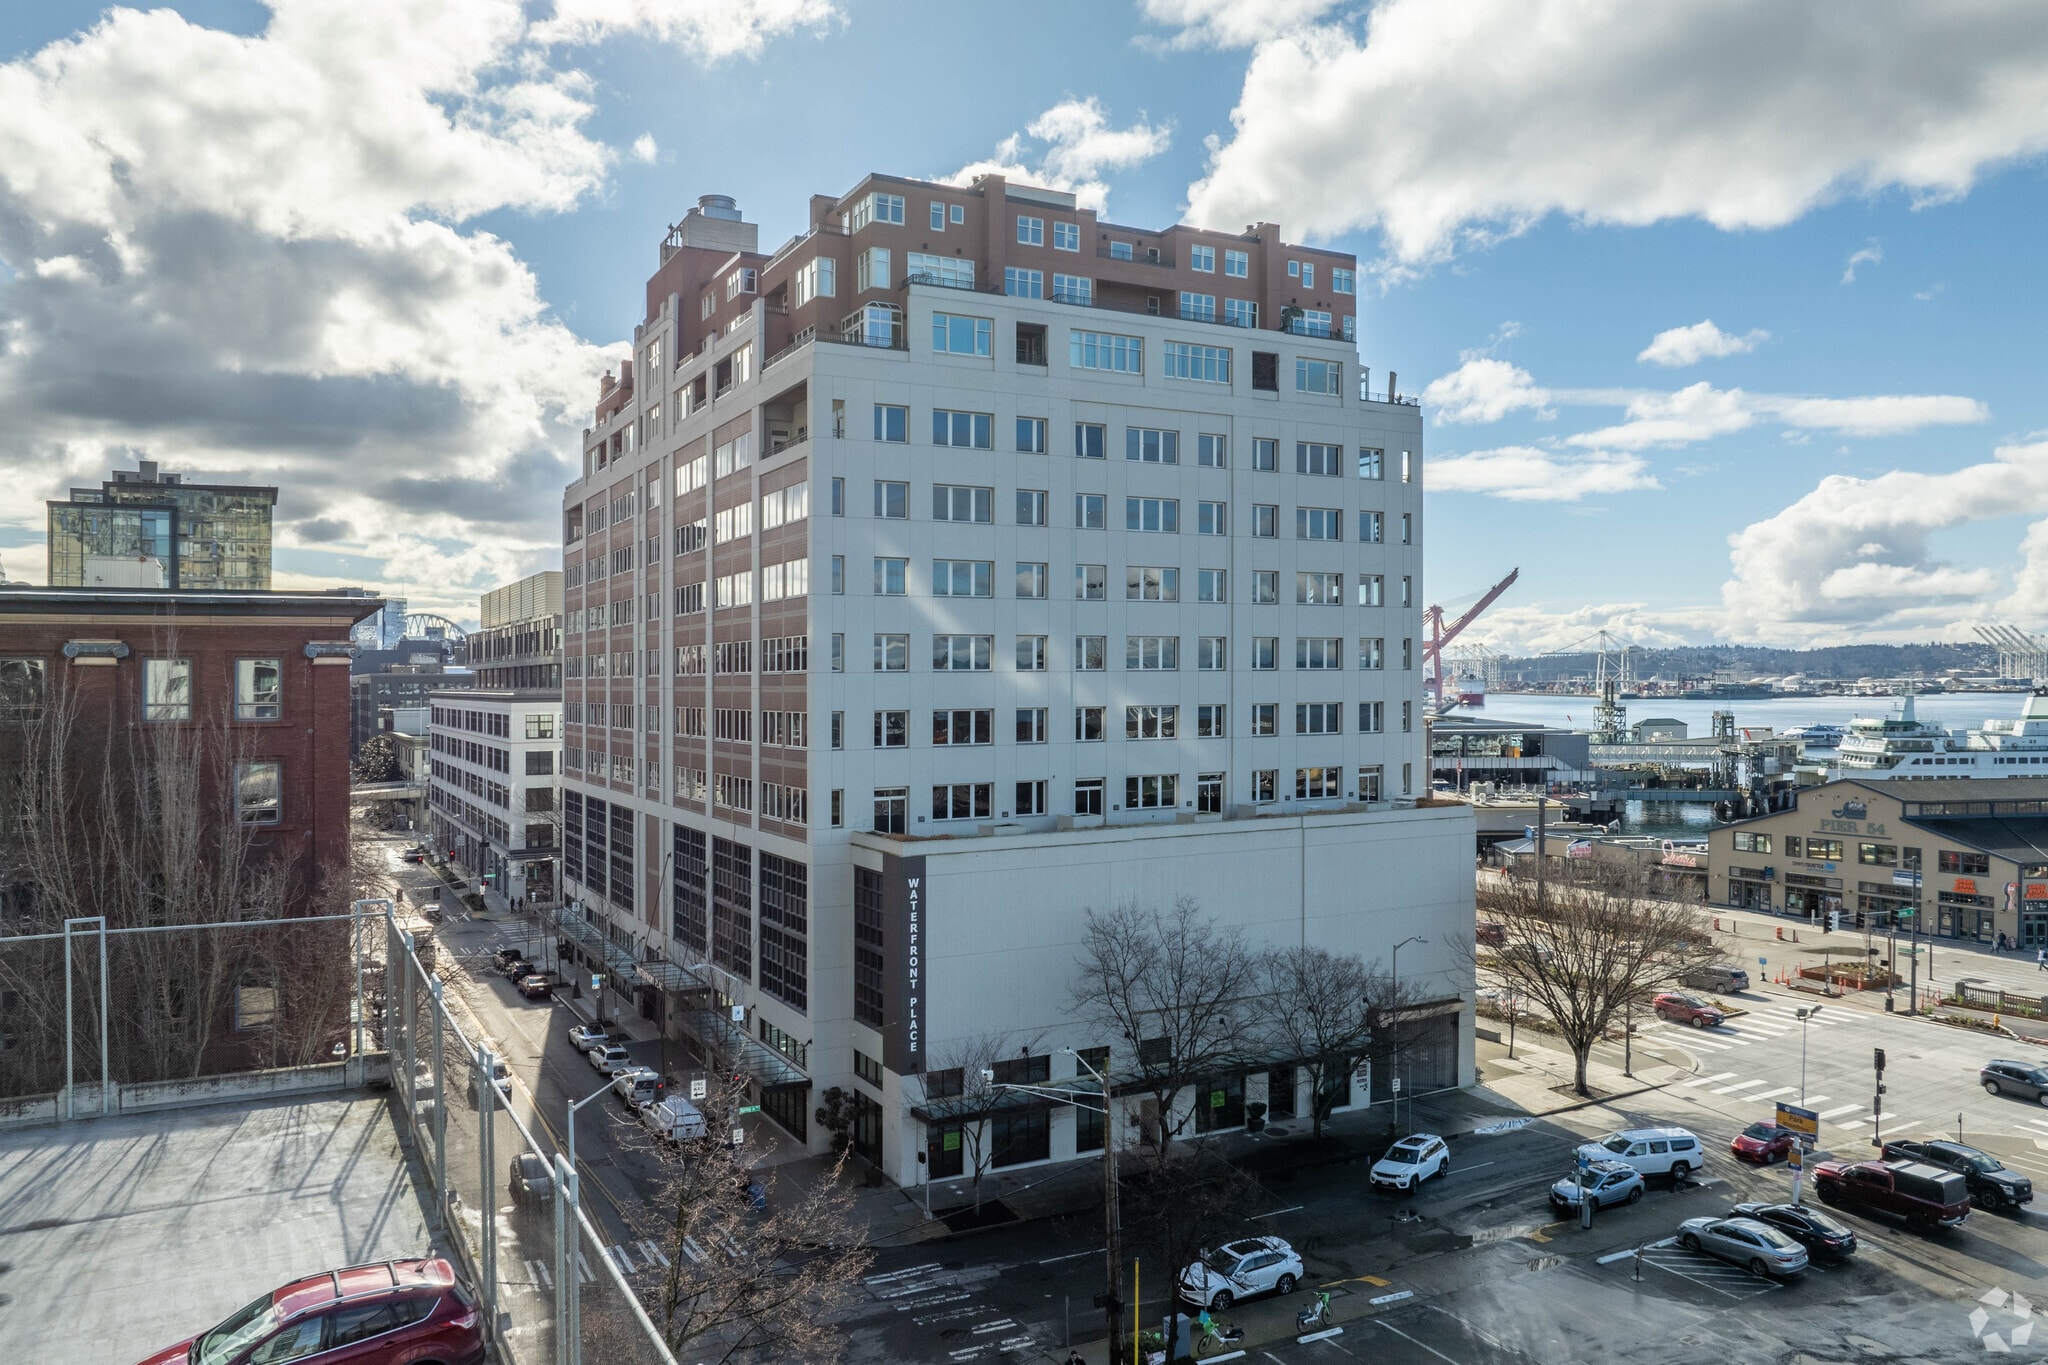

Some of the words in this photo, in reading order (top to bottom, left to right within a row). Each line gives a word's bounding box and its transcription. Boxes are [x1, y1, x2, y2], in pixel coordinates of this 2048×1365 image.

[1821, 819, 1857, 832] PIER
[1867, 823, 1885, 835] 54
[908, 878, 920, 989] WATERFRONT
[910, 998, 918, 1052] PLACE
[1789, 1115, 1803, 1124] Park
